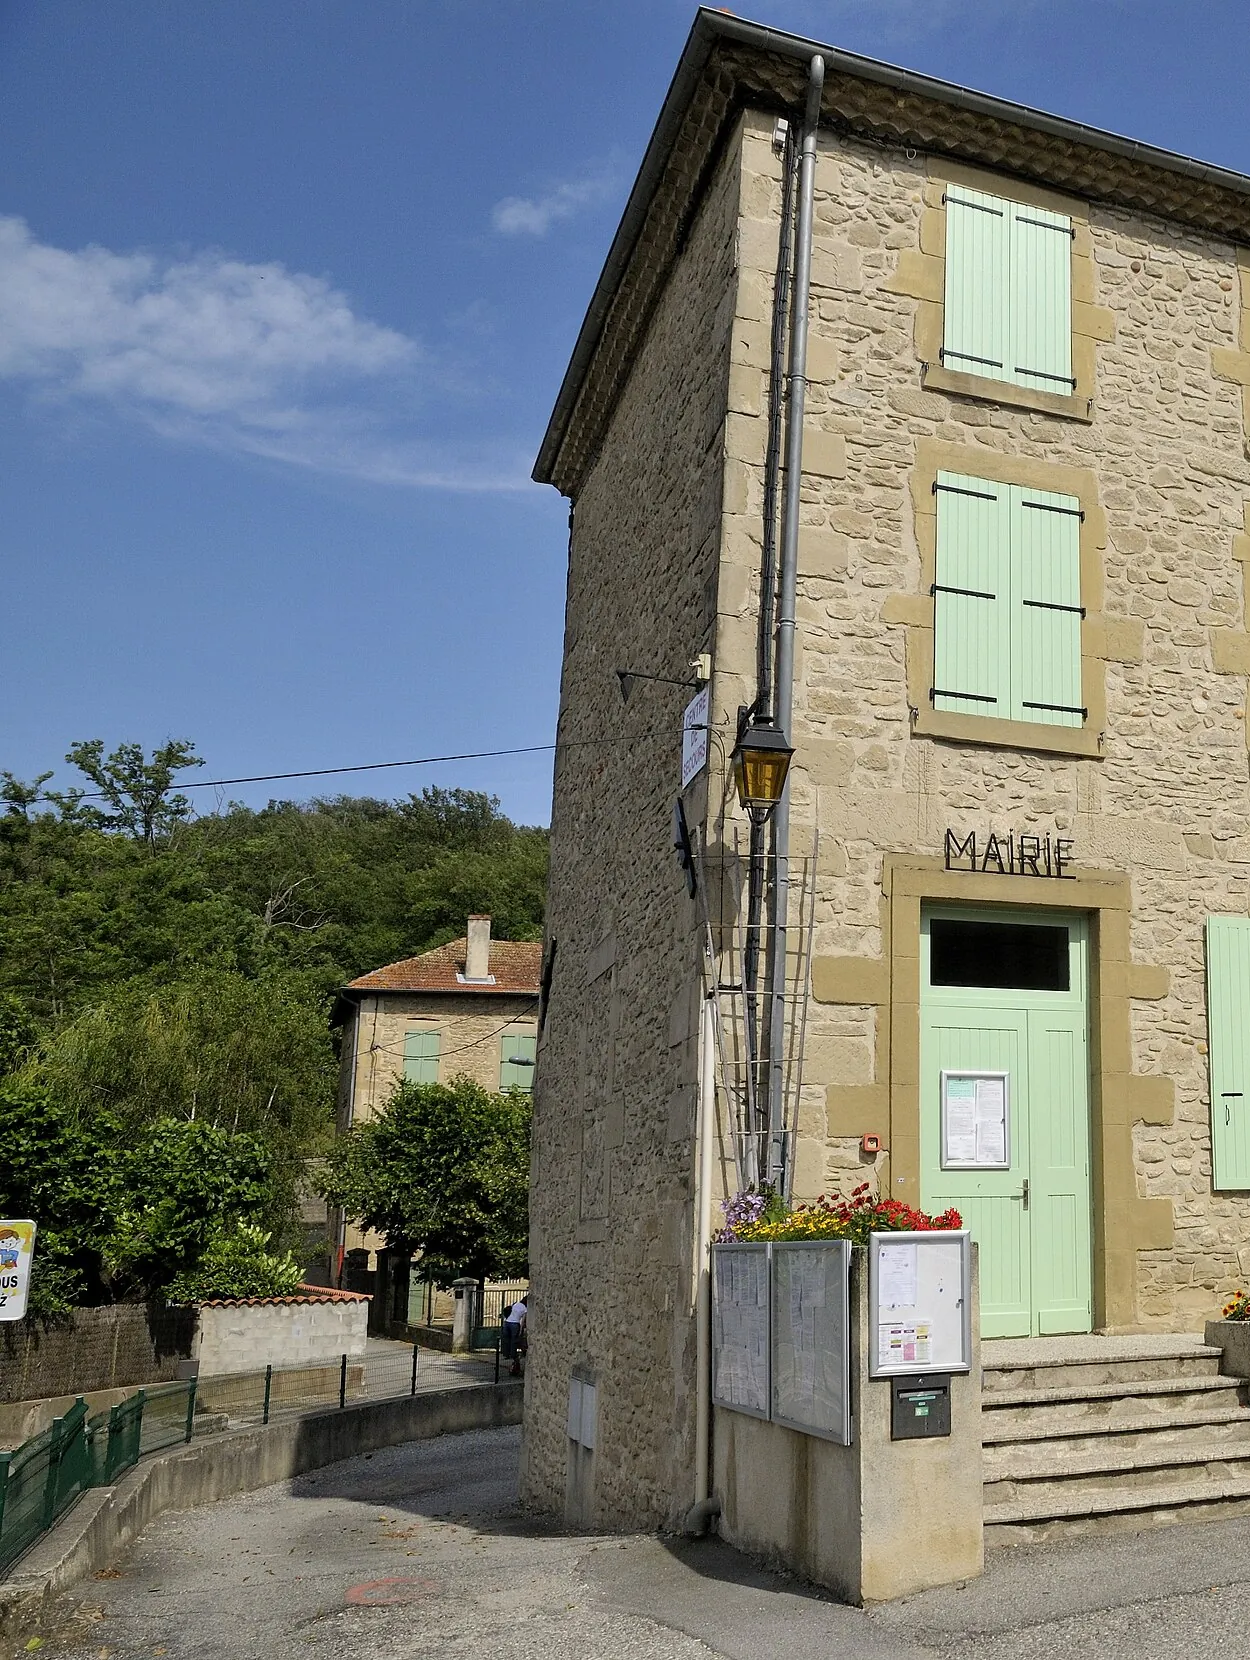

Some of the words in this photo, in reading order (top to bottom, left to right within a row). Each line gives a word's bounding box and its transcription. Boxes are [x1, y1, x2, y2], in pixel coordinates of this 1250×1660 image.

[686, 692, 707, 729] CENTRE
[690, 730, 698, 748] DE
[683, 740, 706, 780] SECOURS
[945, 828, 1076, 880] MAIRIE
[0, 1275, 18, 1289] US
